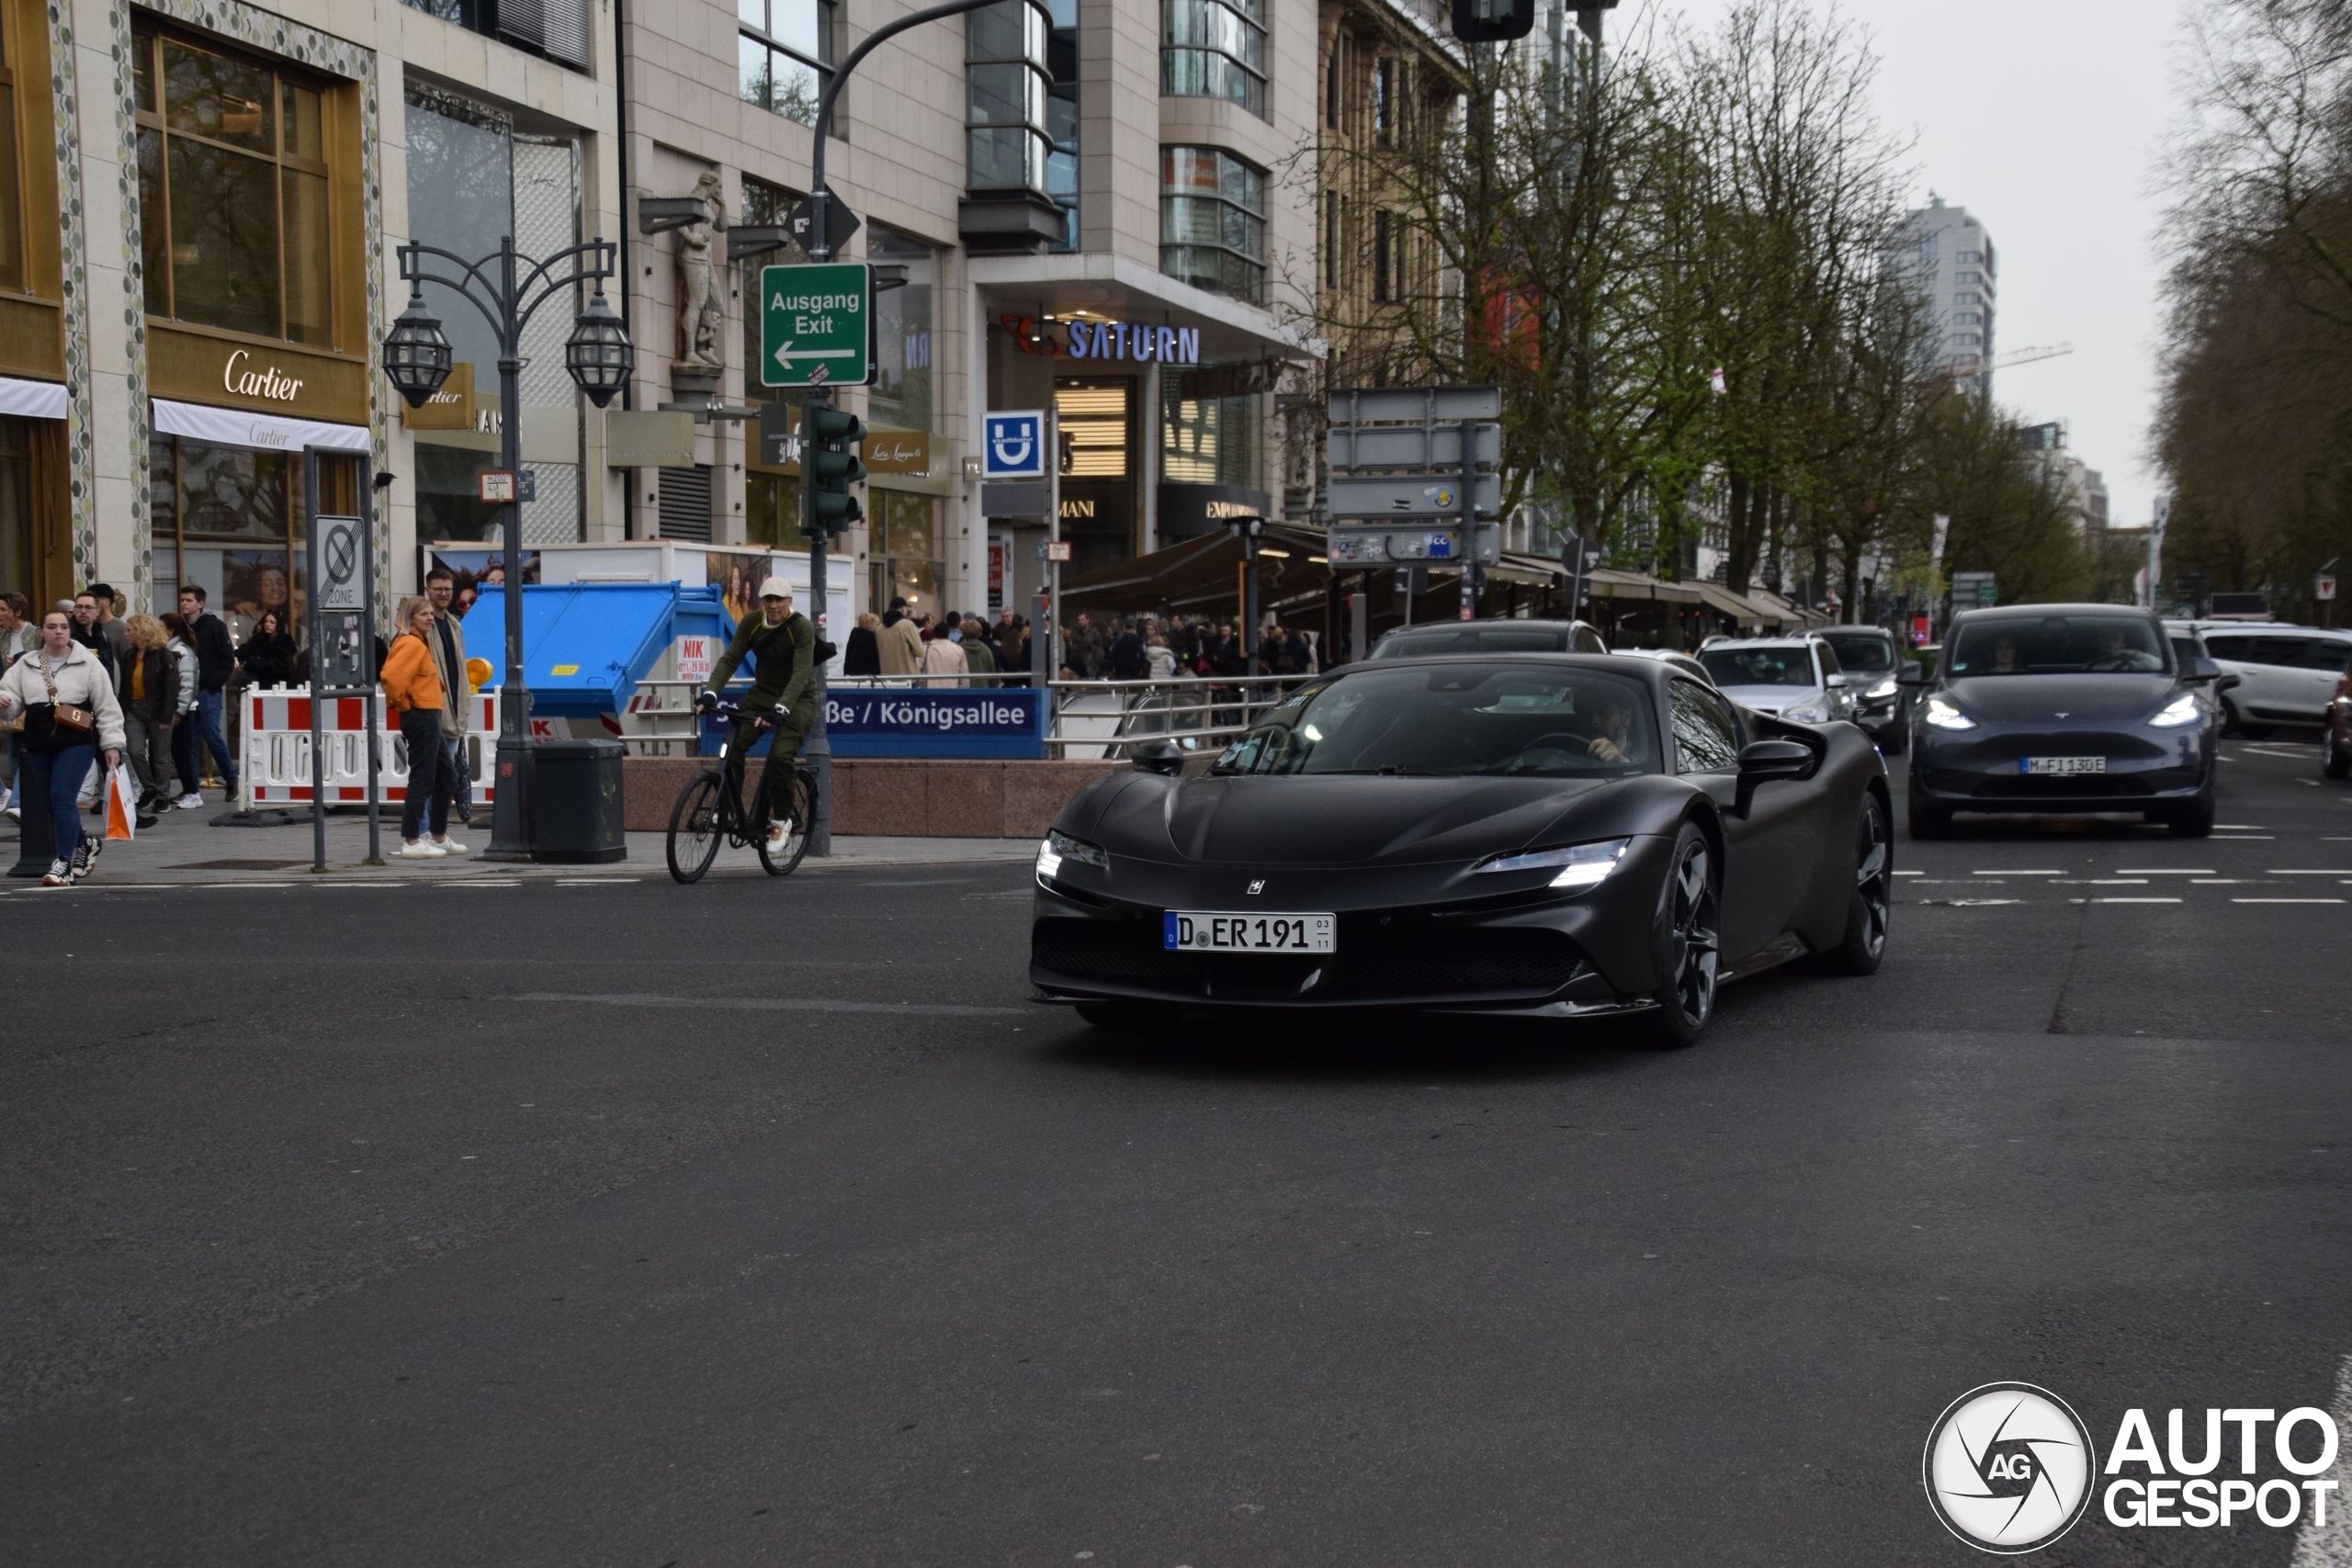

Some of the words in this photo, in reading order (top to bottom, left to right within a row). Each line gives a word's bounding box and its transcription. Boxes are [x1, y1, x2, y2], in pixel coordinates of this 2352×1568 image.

[771, 292, 860, 314] Ausgang
[795, 316, 833, 334] Exit
[1069, 321, 1200, 364] SATURN
[224, 350, 303, 401] Cartier
[426, 390, 462, 404] rtier
[248, 421, 290, 447] Cartier
[329, 590, 354, 604] ZONE
[684, 640, 704, 659] NIK
[882, 702, 1024, 731] Königsallee
[2030, 760, 2039, 772] M
[1178, 917, 1193, 945] D
[1213, 918, 1248, 947] ER
[1255, 919, 1308, 948] 191
[1317, 919, 1329, 928] 03
[1317, 940, 1329, 948] 11
